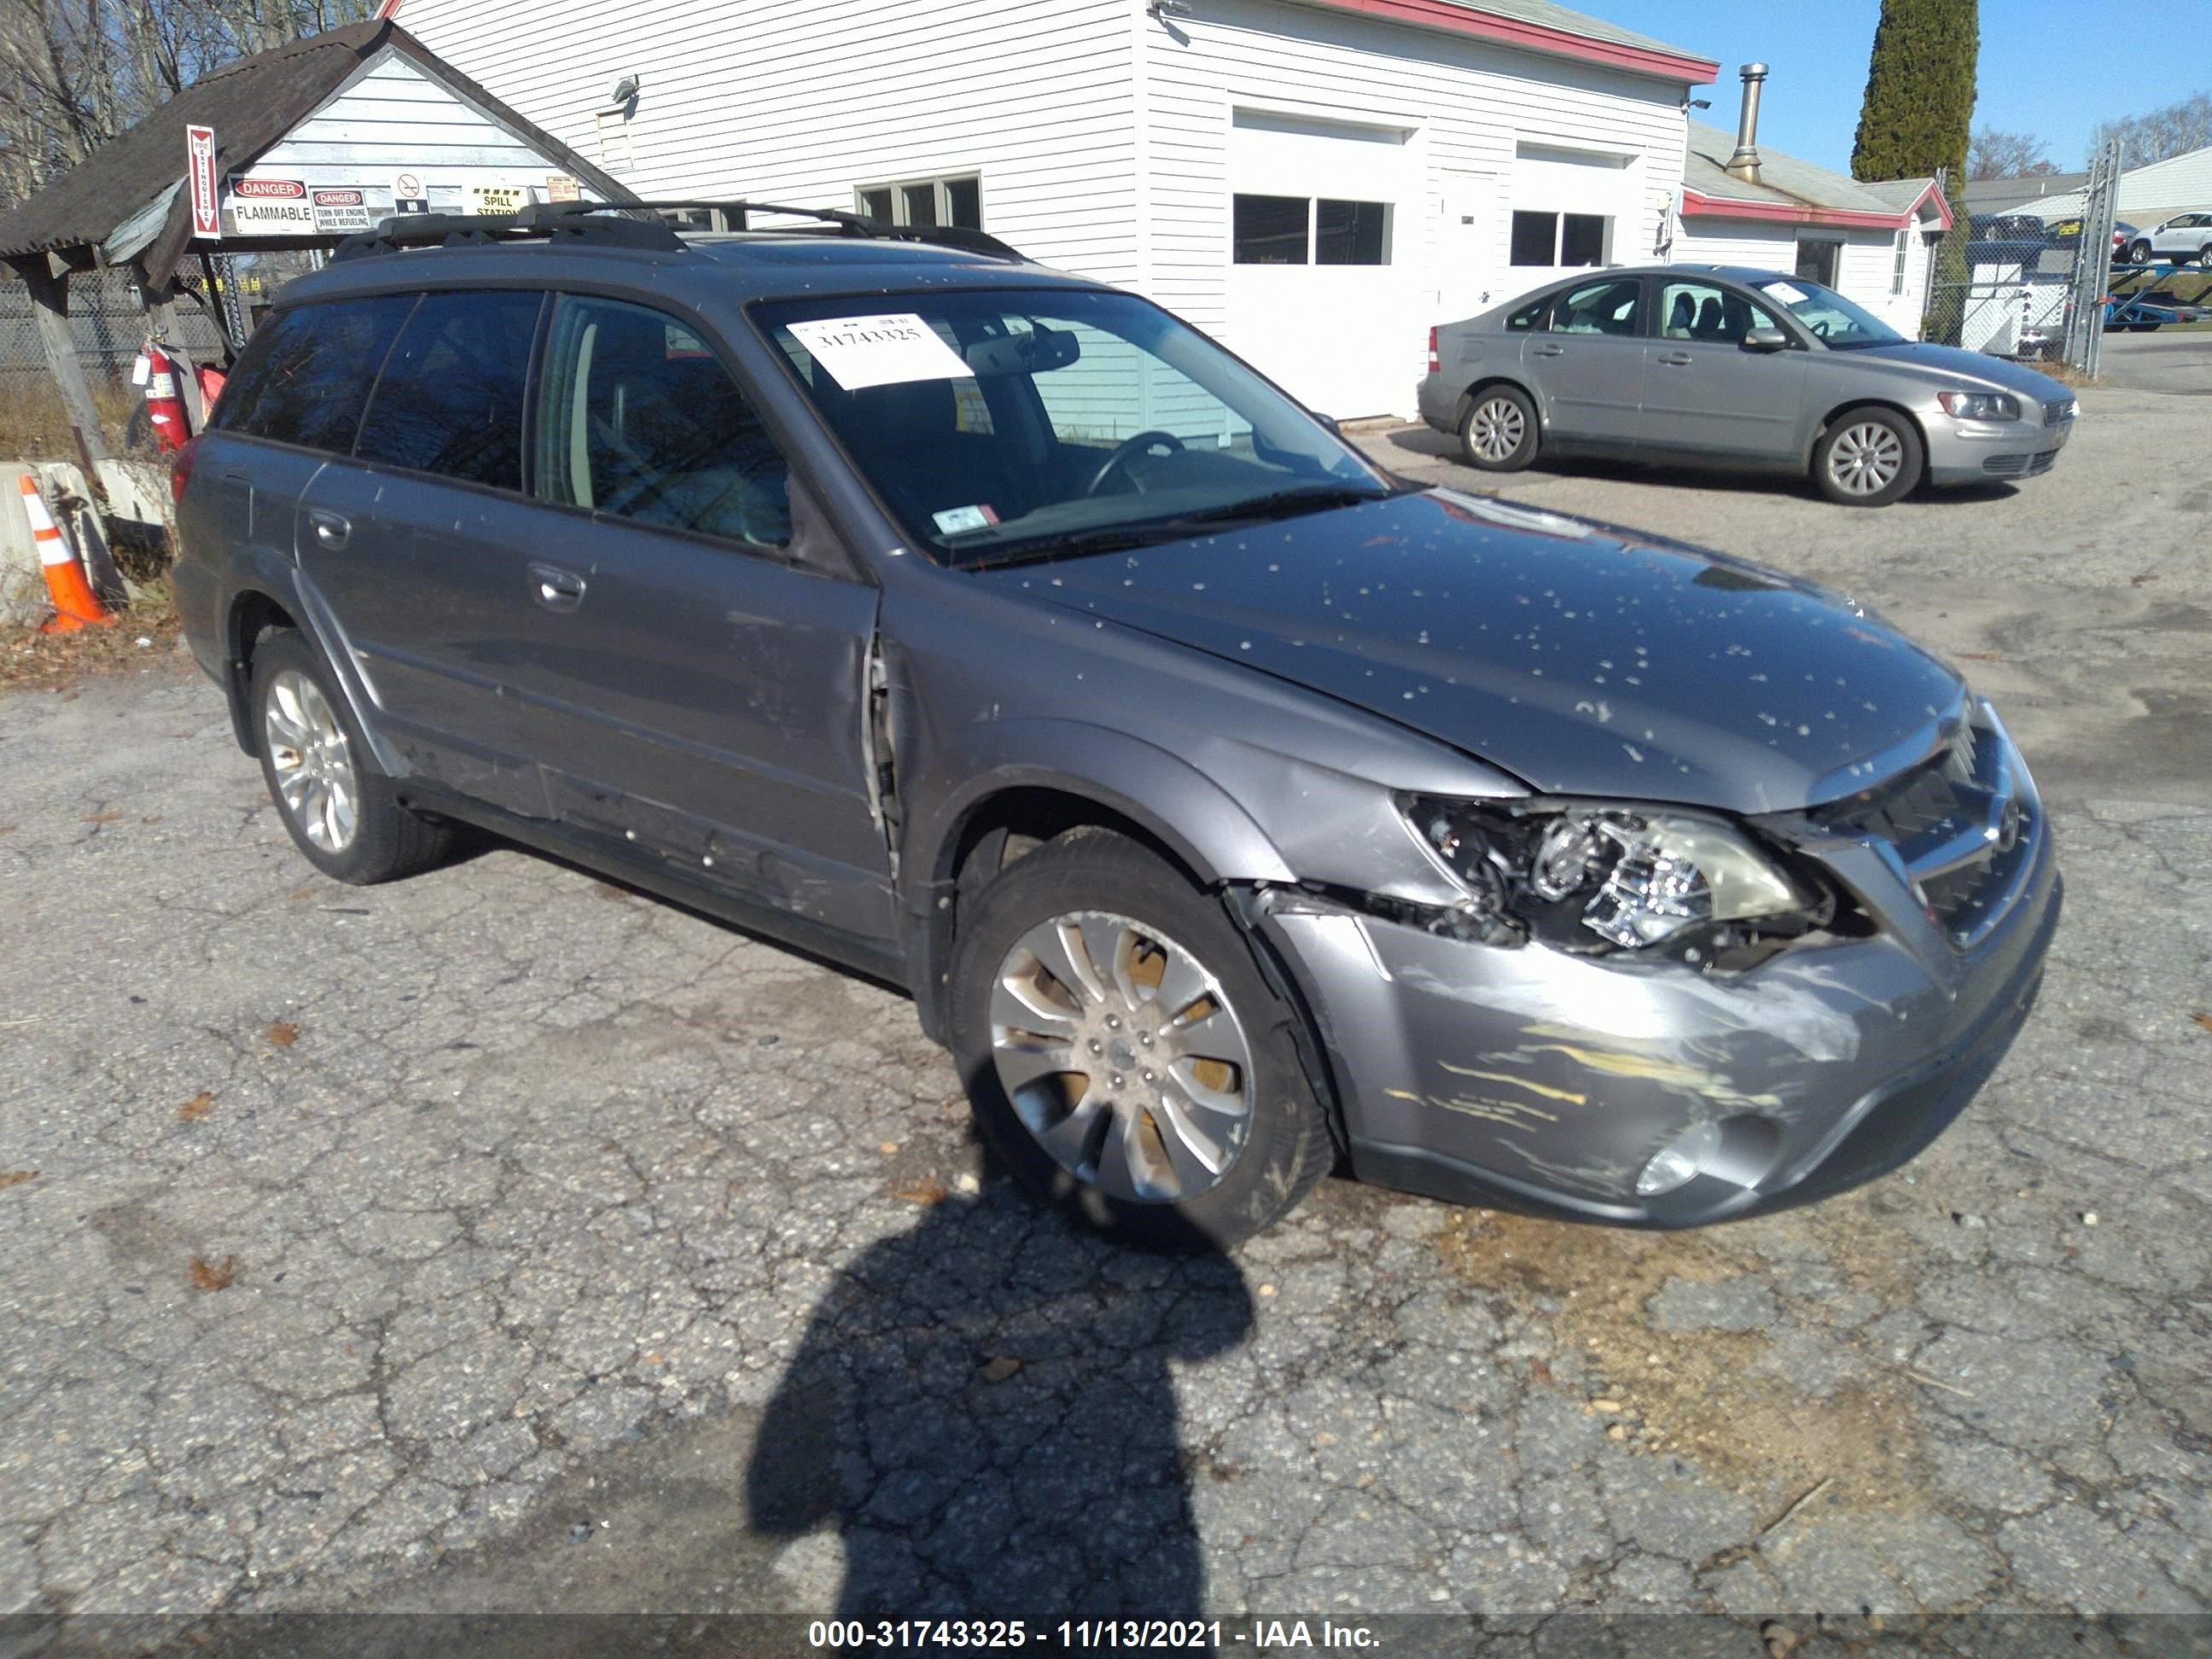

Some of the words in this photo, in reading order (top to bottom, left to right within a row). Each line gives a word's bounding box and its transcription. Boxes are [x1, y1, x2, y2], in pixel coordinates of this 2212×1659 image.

[200, 149, 210, 222] EXTINGUISHER
[243, 183, 296, 195] DANGER
[319, 194, 357, 203] DANGER
[484, 196, 513, 207] SPILL
[407, 201, 418, 212] NO
[236, 206, 311, 221] FLAMMABLE
[334, 208, 344, 217] OFF
[319, 218, 337, 227] WHILE
[338, 218, 370, 227] REFUELING
[818, 329, 922, 349] 31743325
